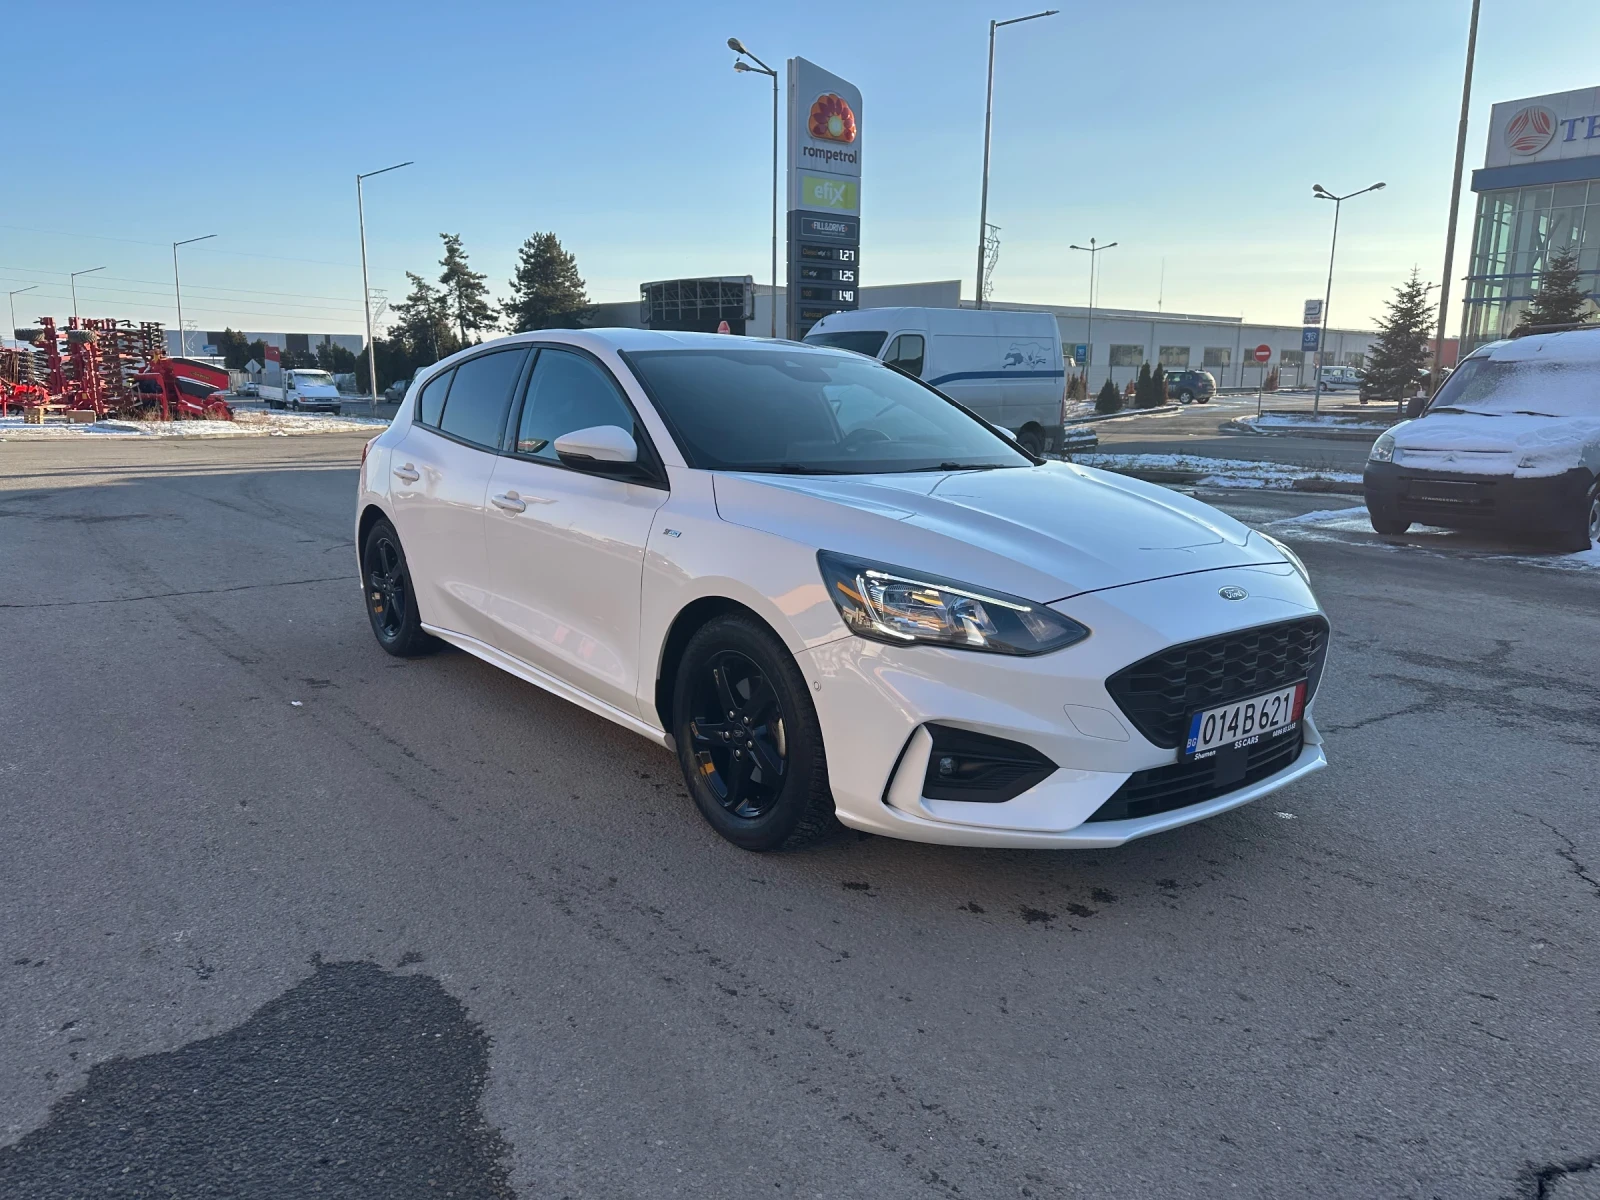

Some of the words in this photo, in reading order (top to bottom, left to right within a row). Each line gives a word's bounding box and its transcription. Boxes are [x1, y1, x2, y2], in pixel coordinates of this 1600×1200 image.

[803, 146, 857, 164] rompetrol
[814, 181, 846, 205] efix
[813, 221, 846, 232] FILL&DRIVE
[1187, 738, 1197, 749] BG
[1234, 740, 1243, 750] SS
[1243, 735, 1259, 747] CARS
